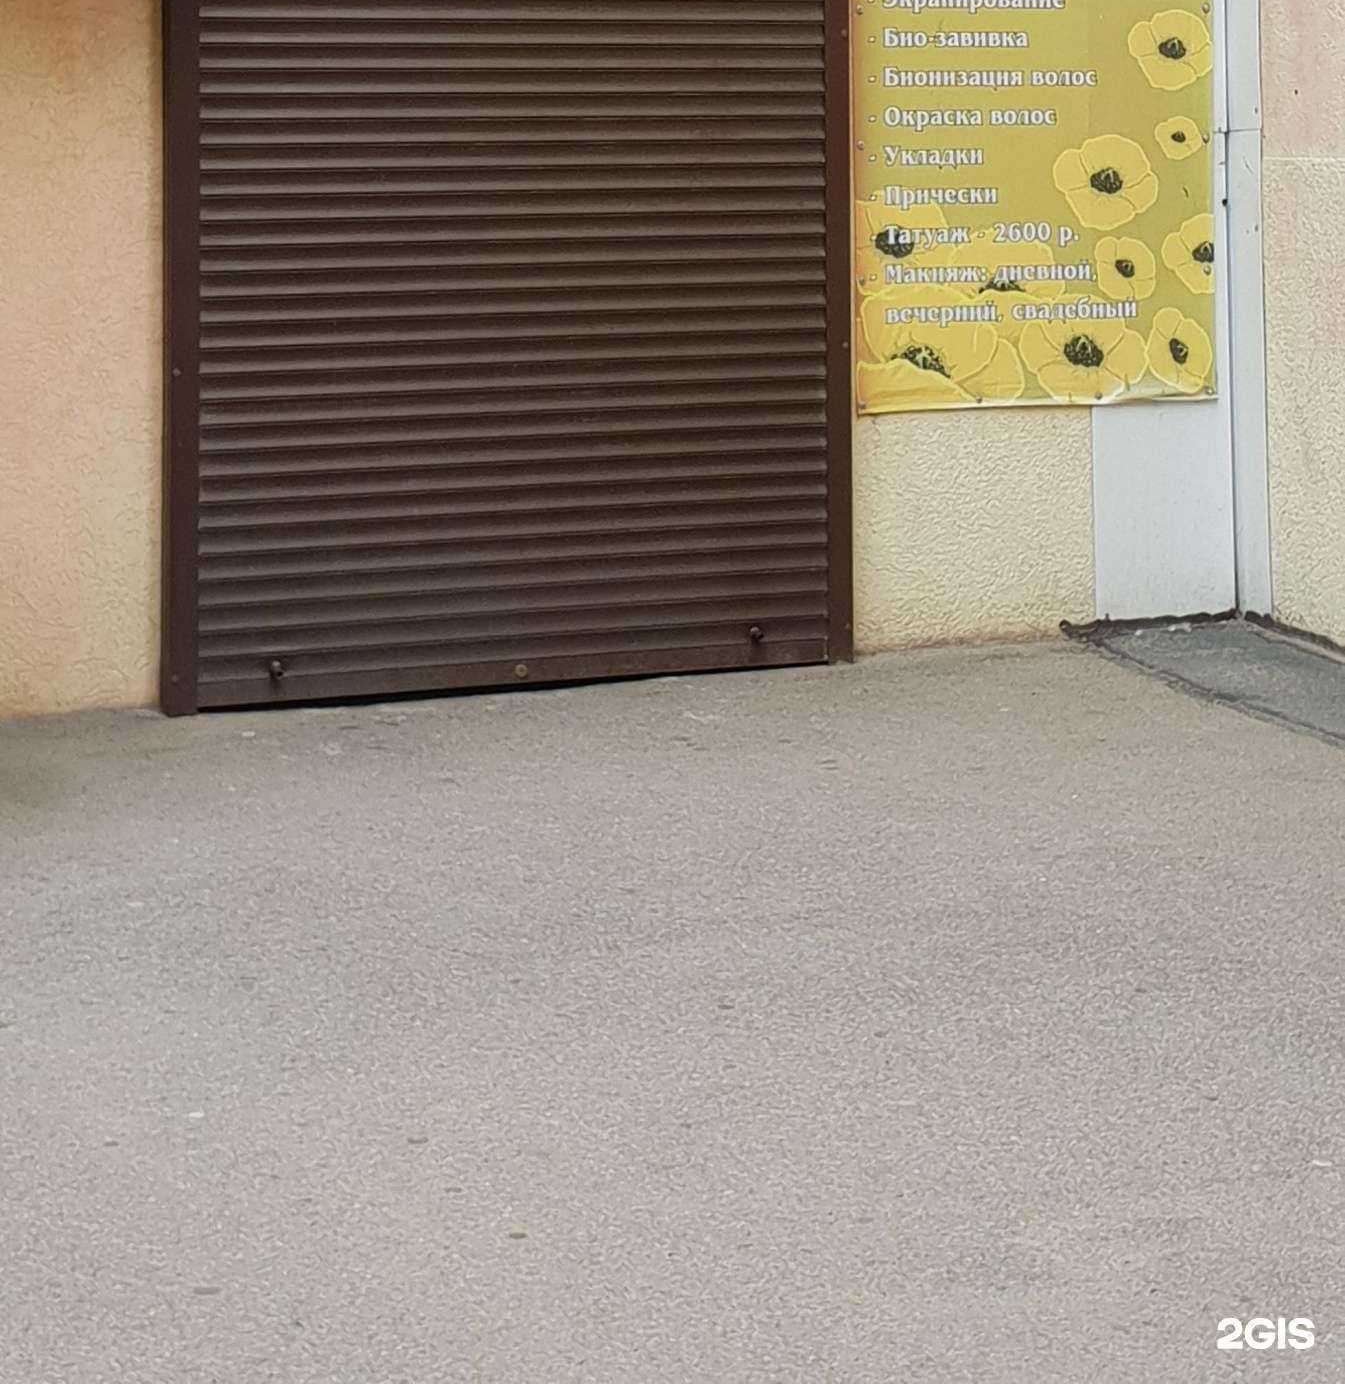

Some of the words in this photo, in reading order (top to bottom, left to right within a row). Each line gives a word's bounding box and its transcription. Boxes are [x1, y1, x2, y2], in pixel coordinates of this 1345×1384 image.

[882, 28, 1029, 48] Био-завивка
[883, 67, 1023, 92] Бионизация
[1031, 68, 1098, 87] волос
[884, 107, 982, 132] Окраска
[990, 107, 1057, 126] волос
[884, 145, 984, 170] Укладки
[885, 185, 998, 210] Прически
[885, 225, 969, 247] Татуаж
[992, 223, 1051, 244] 2600
[1059, 227, 1080, 246] р.
[886, 264, 988, 285] Макияж:
[996, 260, 1098, 284] дневной,
[886, 303, 1004, 326] вечерний,
[1012, 298, 1138, 324] свадебный
